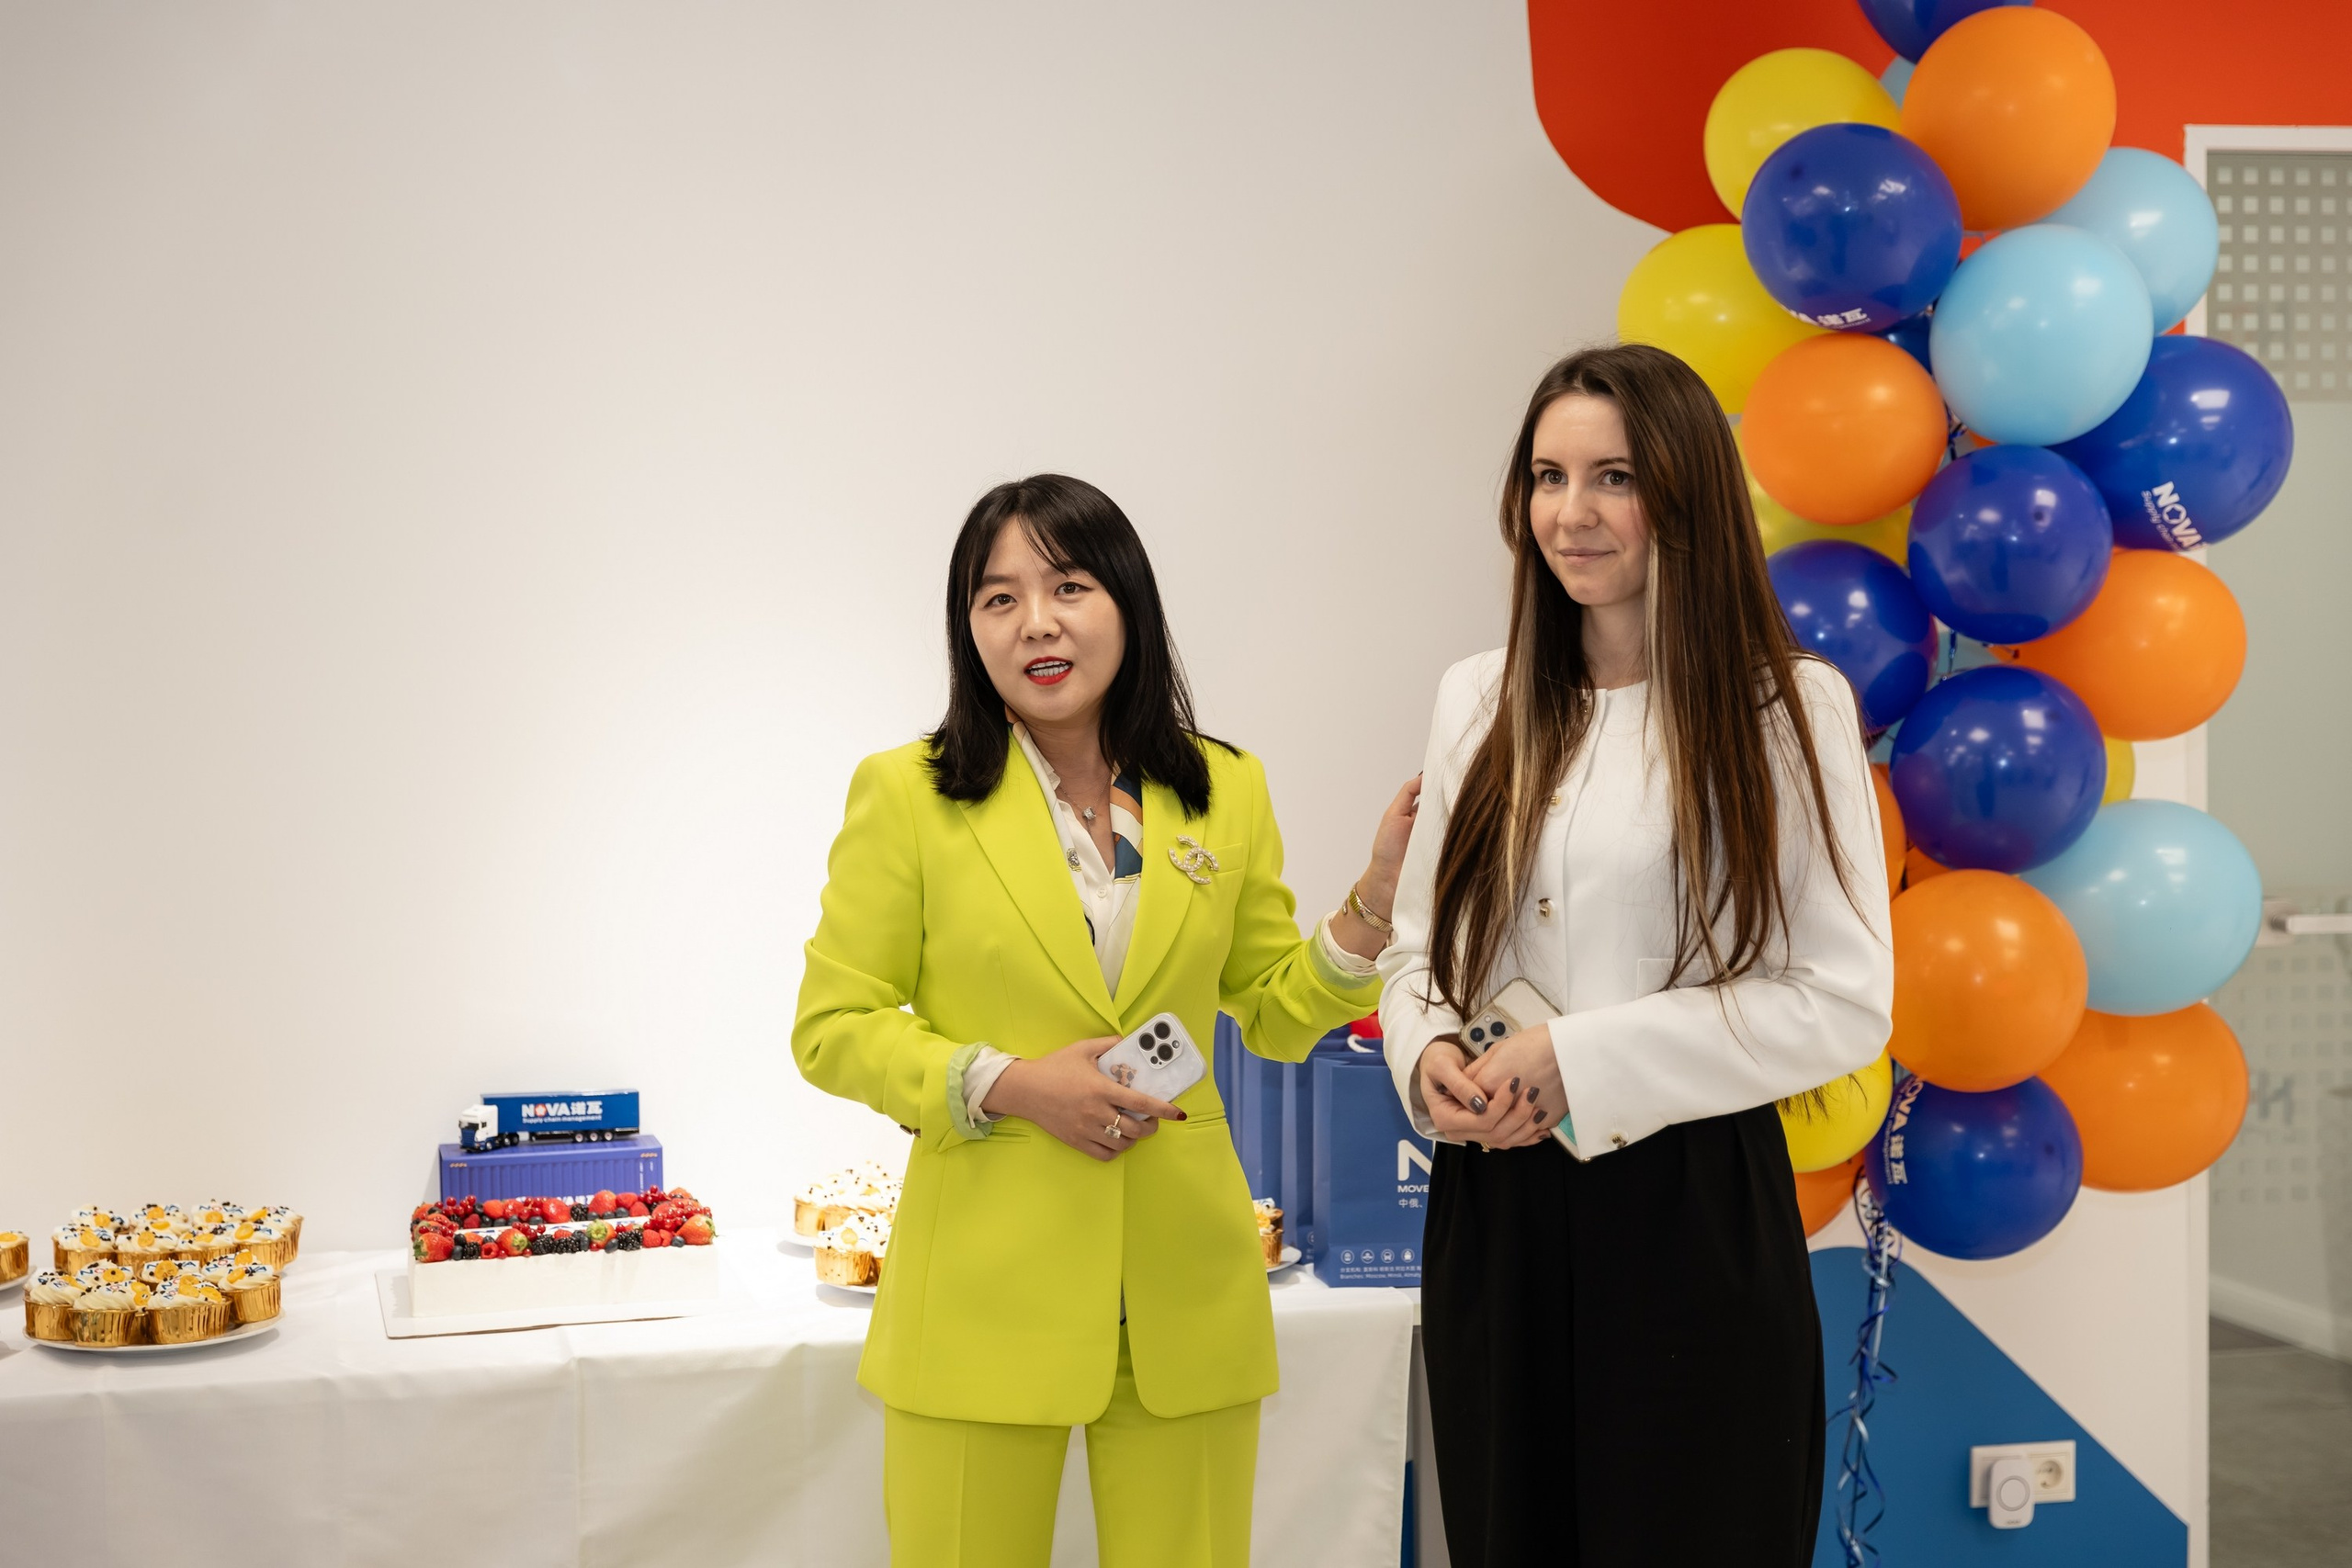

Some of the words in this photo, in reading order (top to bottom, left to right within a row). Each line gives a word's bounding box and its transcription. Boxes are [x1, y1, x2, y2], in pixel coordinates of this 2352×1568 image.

[2152, 480, 2202, 548] NOVA
[521, 1102, 571, 1118] NOVA
[1893, 1080, 1924, 1133] OVA
[1397, 1185, 1430, 1193] MOVE
